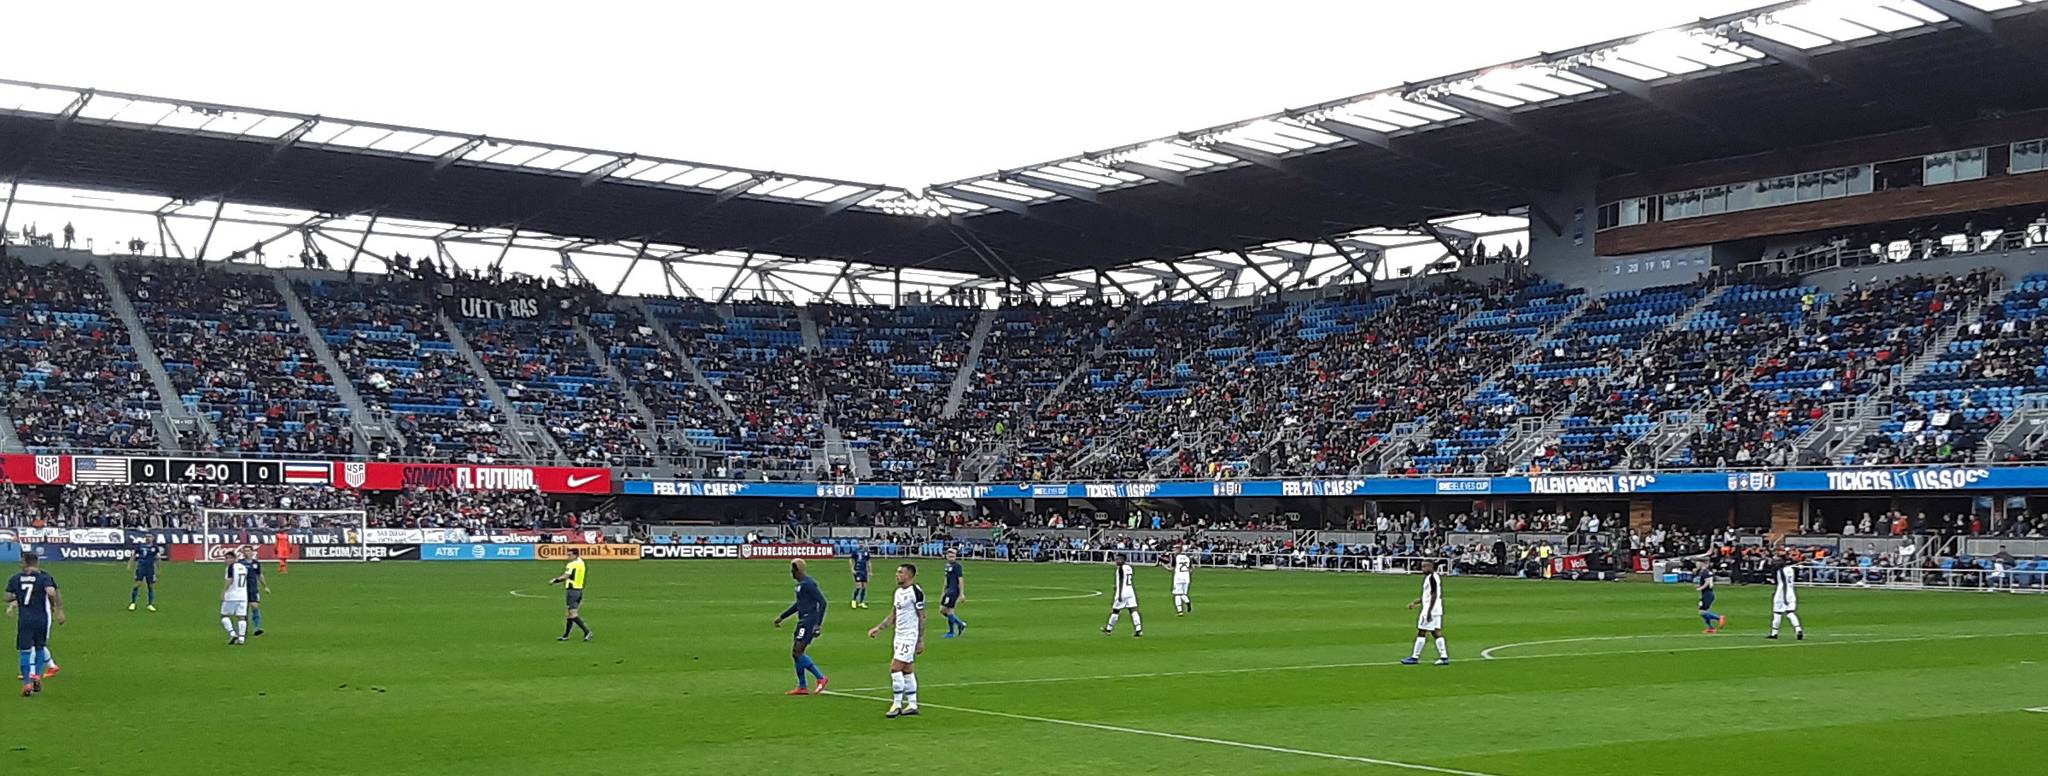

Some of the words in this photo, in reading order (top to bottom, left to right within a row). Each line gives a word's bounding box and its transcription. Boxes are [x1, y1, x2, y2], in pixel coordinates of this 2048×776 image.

[436, 547, 460, 557] AT&T
[497, 547, 521, 556] AT&T
[538, 544, 601, 558] Contintal
[641, 545, 738, 557] POWERADE
[21, 583, 33, 605] 7
